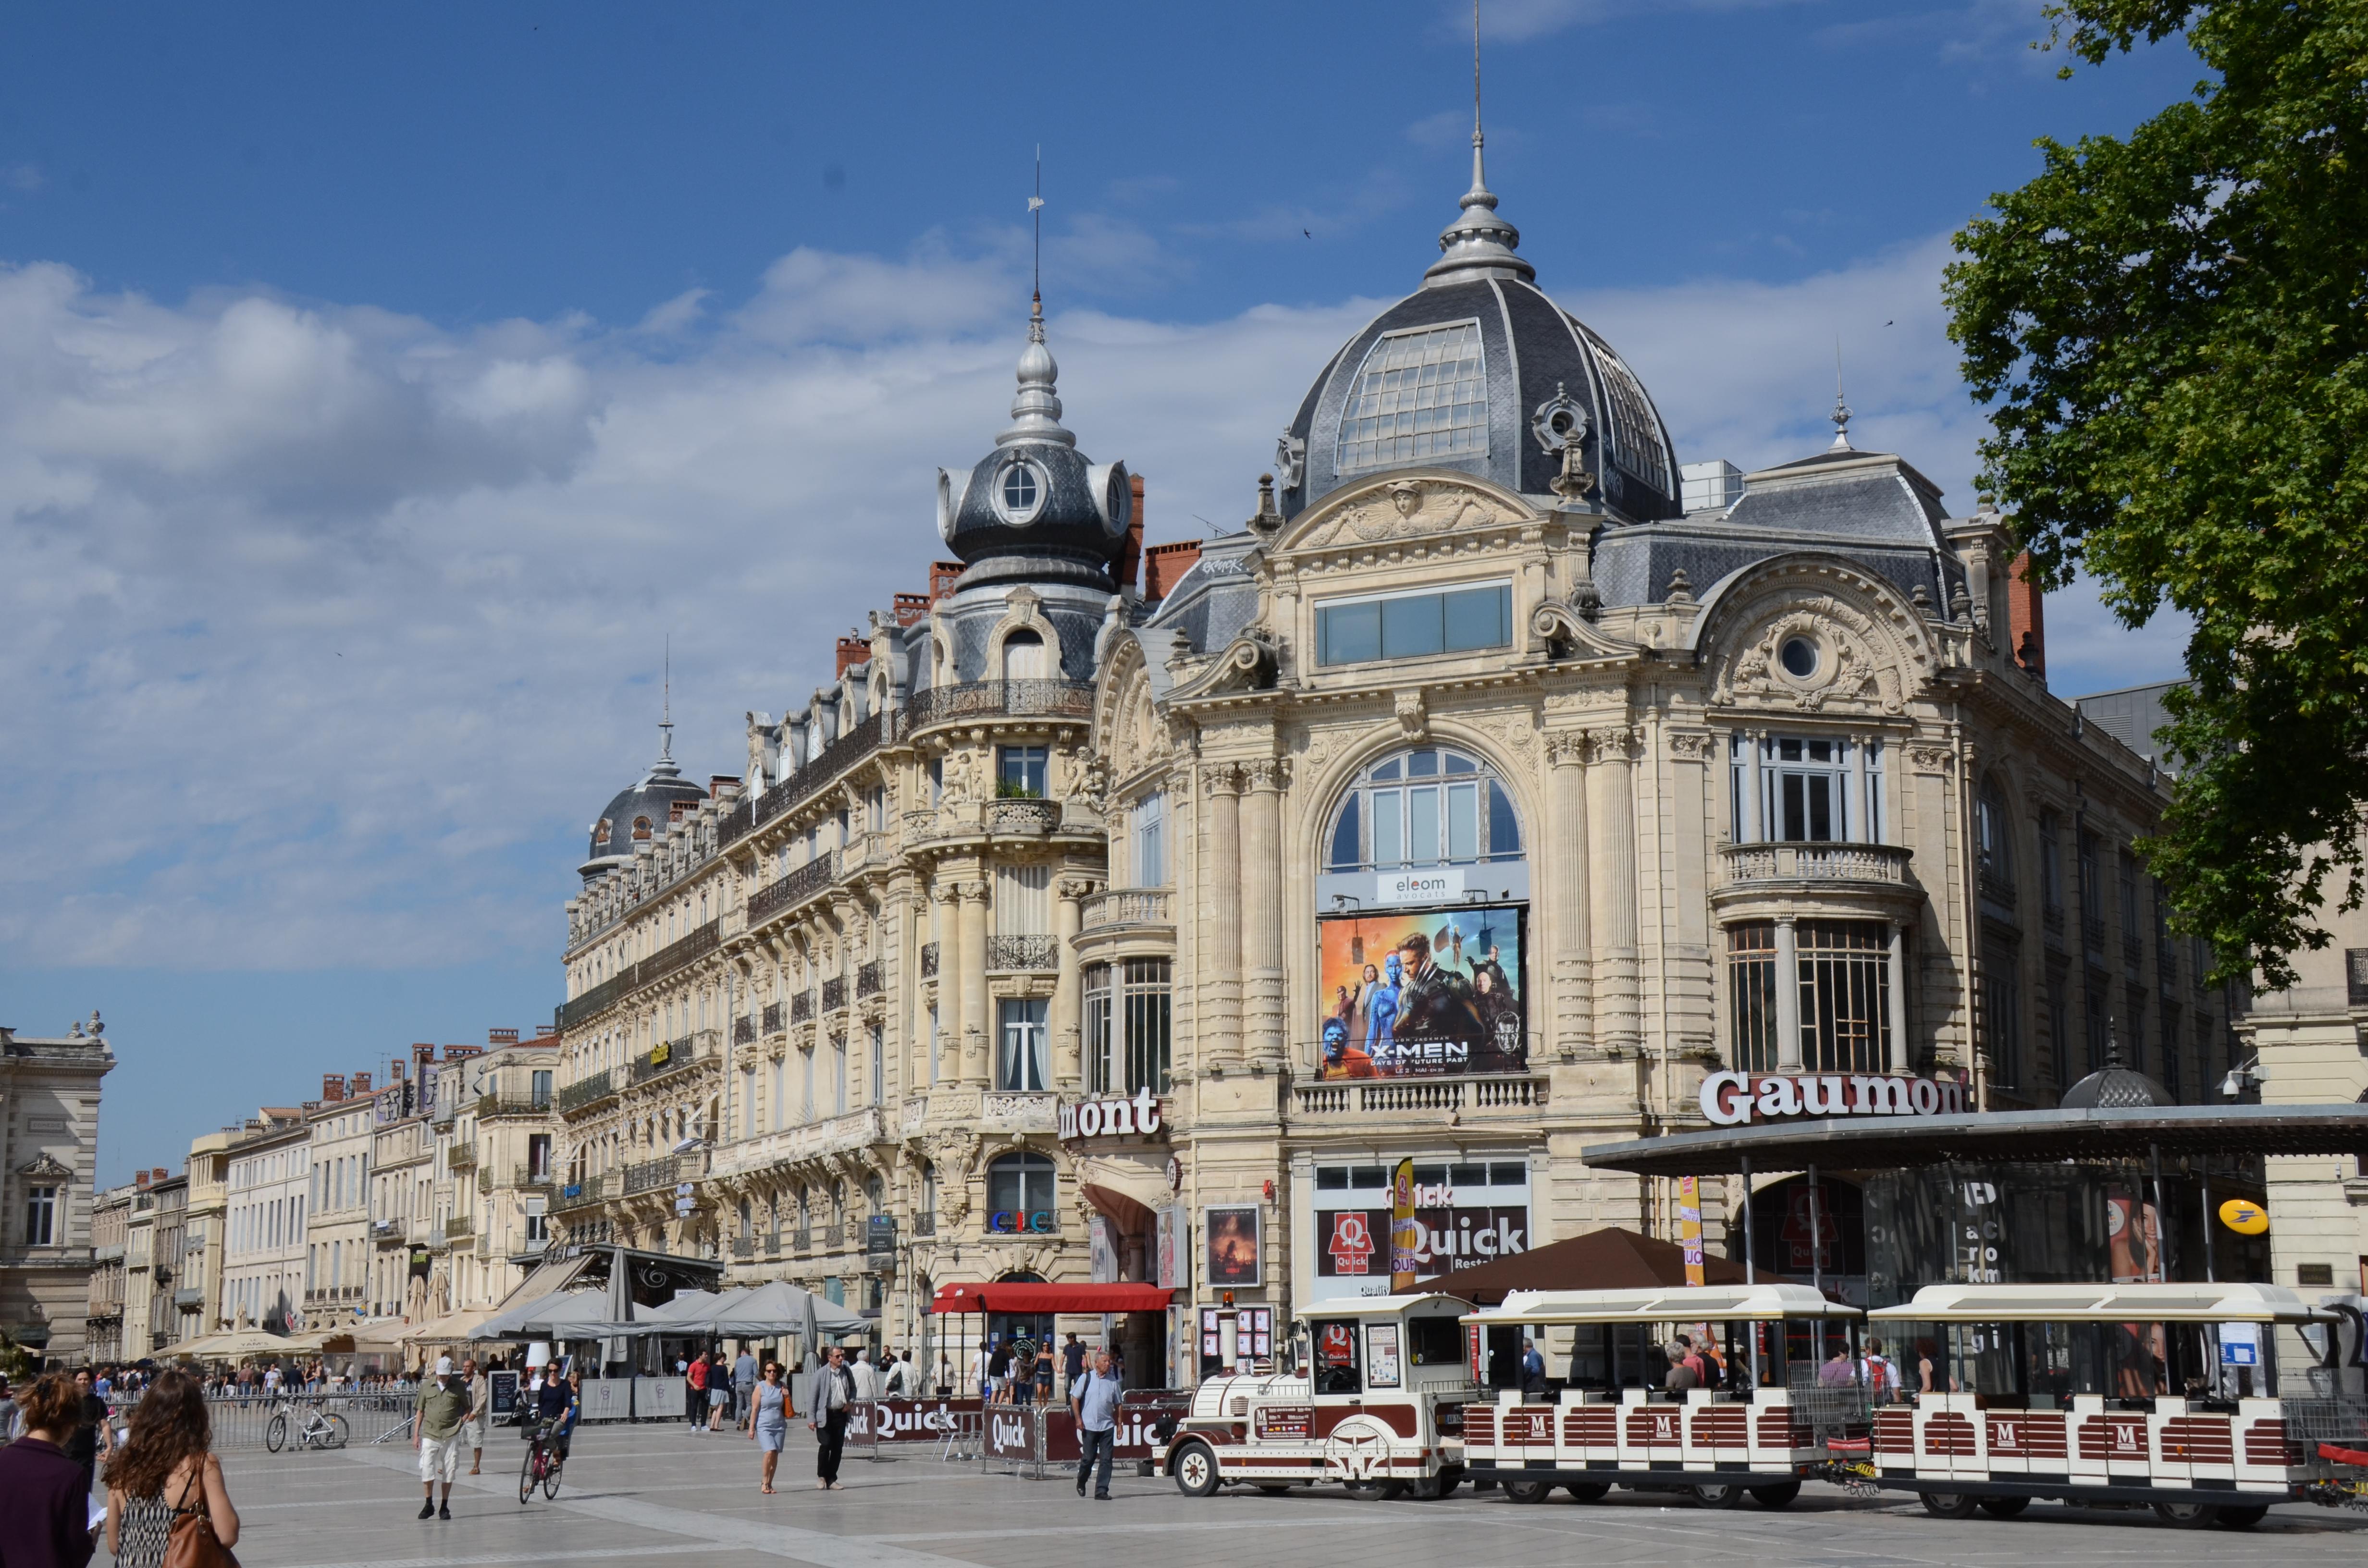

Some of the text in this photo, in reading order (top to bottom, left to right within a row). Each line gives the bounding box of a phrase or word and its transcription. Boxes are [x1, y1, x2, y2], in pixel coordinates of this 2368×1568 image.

[1396, 876, 1445, 891] eleom
[1396, 891, 1445, 900] avocats
[1371, 1041, 1468, 1059] X-MEN
[1058, 1086, 1159, 1141] mont
[1169, 1165, 1174, 1183] G
[991, 1211, 1049, 1232] CIC
[1339, 1219, 1365, 1248] Q
[1337, 1257, 1367, 1266] Quick
[877, 1403, 958, 1438] Quick
[1256, 1409, 1267, 1421] M
[1531, 1416, 1546, 1431] M
[1656, 1416, 1672, 1432] M
[993, 1413, 1026, 1454] Quick
[1997, 1423, 2015, 1440] M
[2116, 1426, 2136, 1444] M
